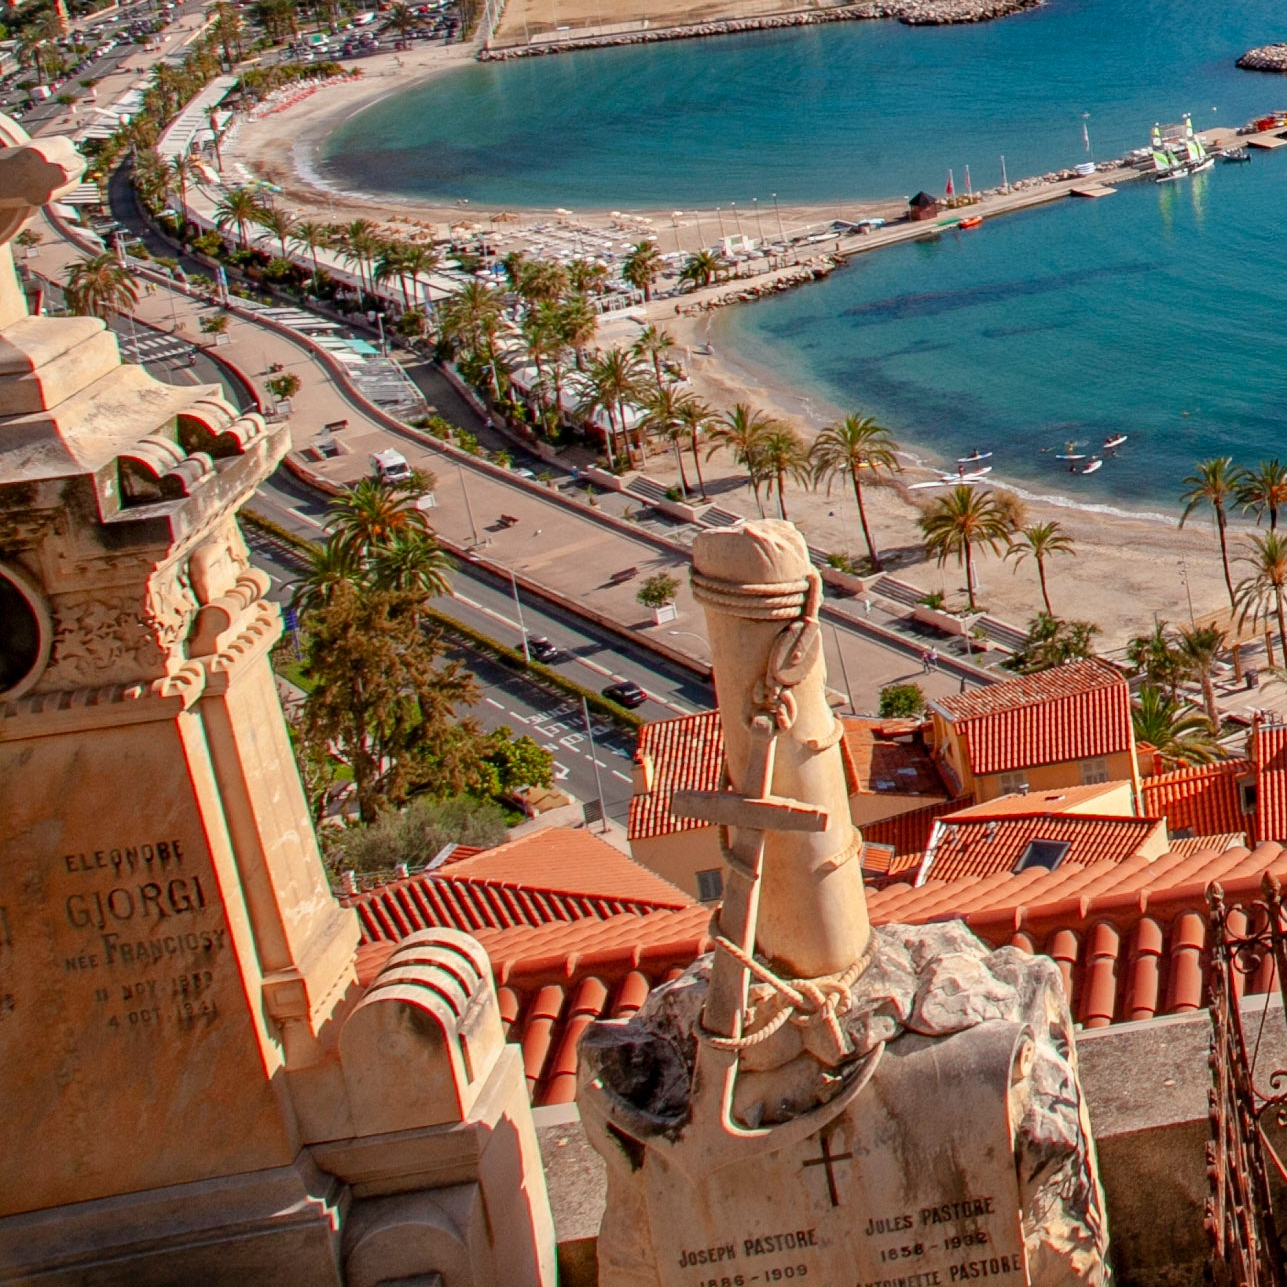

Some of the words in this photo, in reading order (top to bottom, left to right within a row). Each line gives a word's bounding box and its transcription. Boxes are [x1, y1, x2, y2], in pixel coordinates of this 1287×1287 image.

[65, 950, 99, 972] NÉE
[128, 1007, 161, 1026] OCT
[865, 1214, 914, 1236] JULES
[918, 1197, 996, 1226] PASTORE
[679, 1244, 737, 1269] JOSEPH
[743, 1227, 819, 1258] PASTORE
[764, 1263, 809, 1284] 1909
[949, 1253, 1023, 1283] PASTORE
